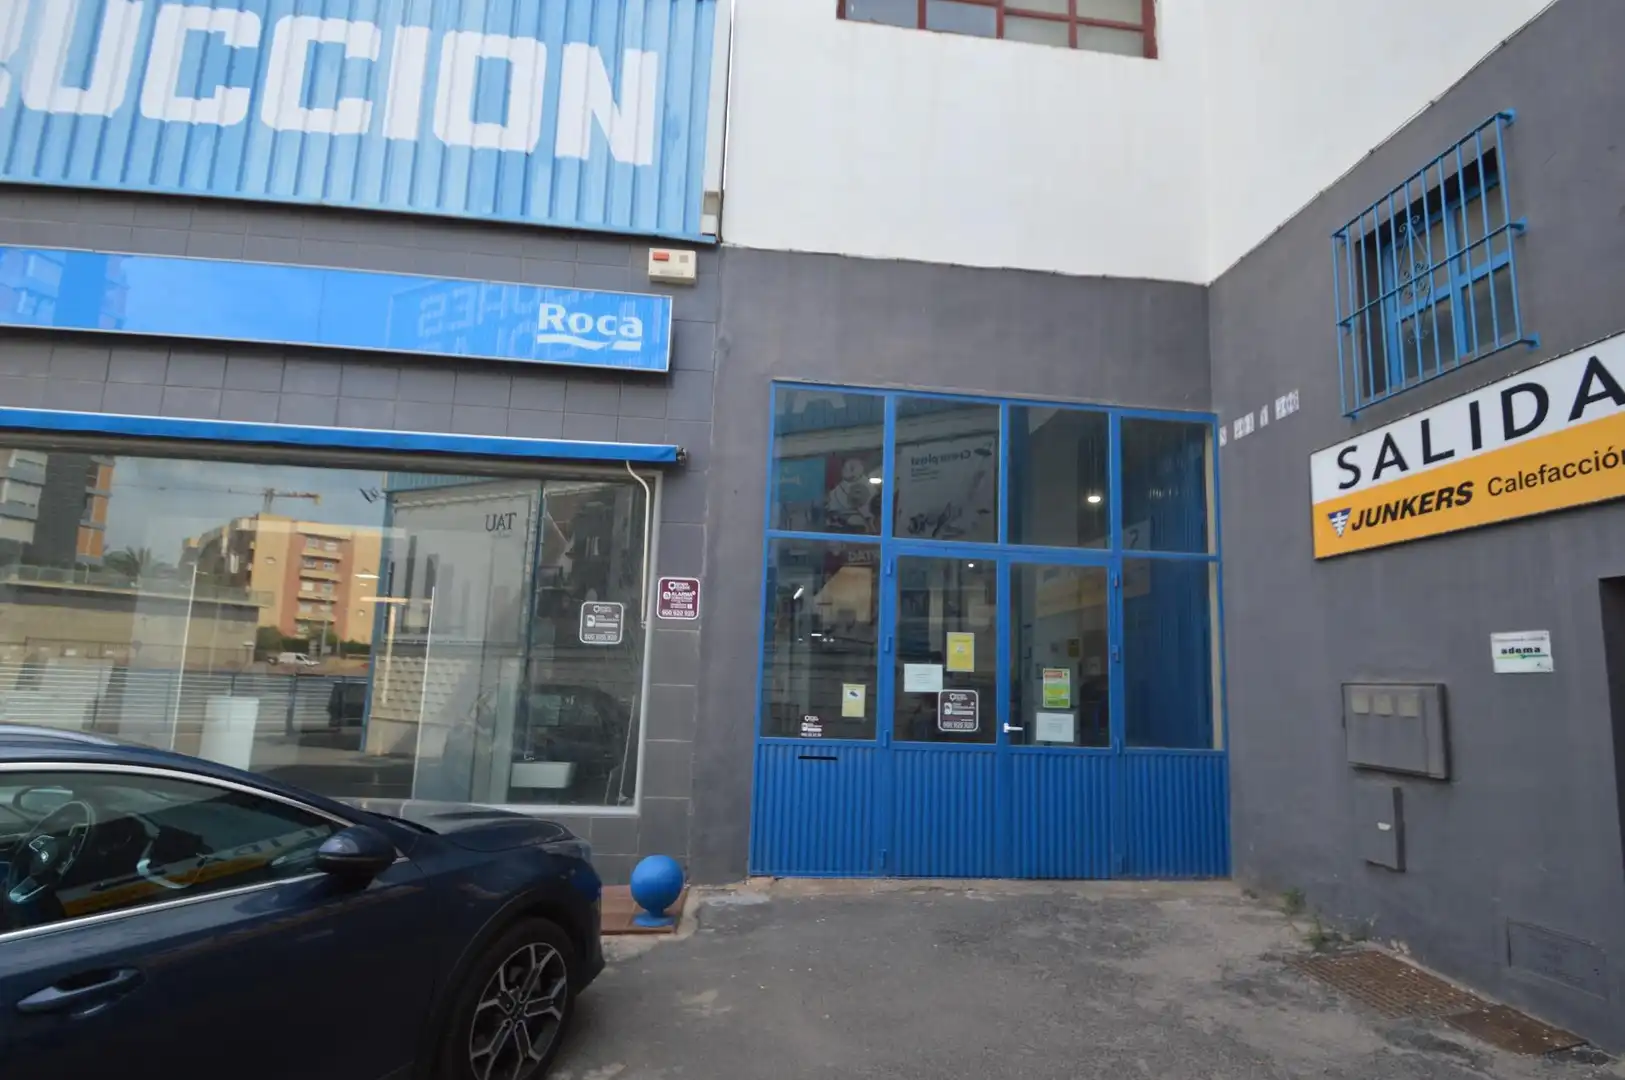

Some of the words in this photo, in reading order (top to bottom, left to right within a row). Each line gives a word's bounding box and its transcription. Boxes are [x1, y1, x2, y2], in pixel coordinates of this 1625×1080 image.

[0, 0, 659, 166] UCCION
[538, 302, 643, 339] Roca
[1336, 355, 1625, 490] SALIDA
[1351, 481, 1475, 531] JUNKERS
[1501, 647, 1541, 655] adema
